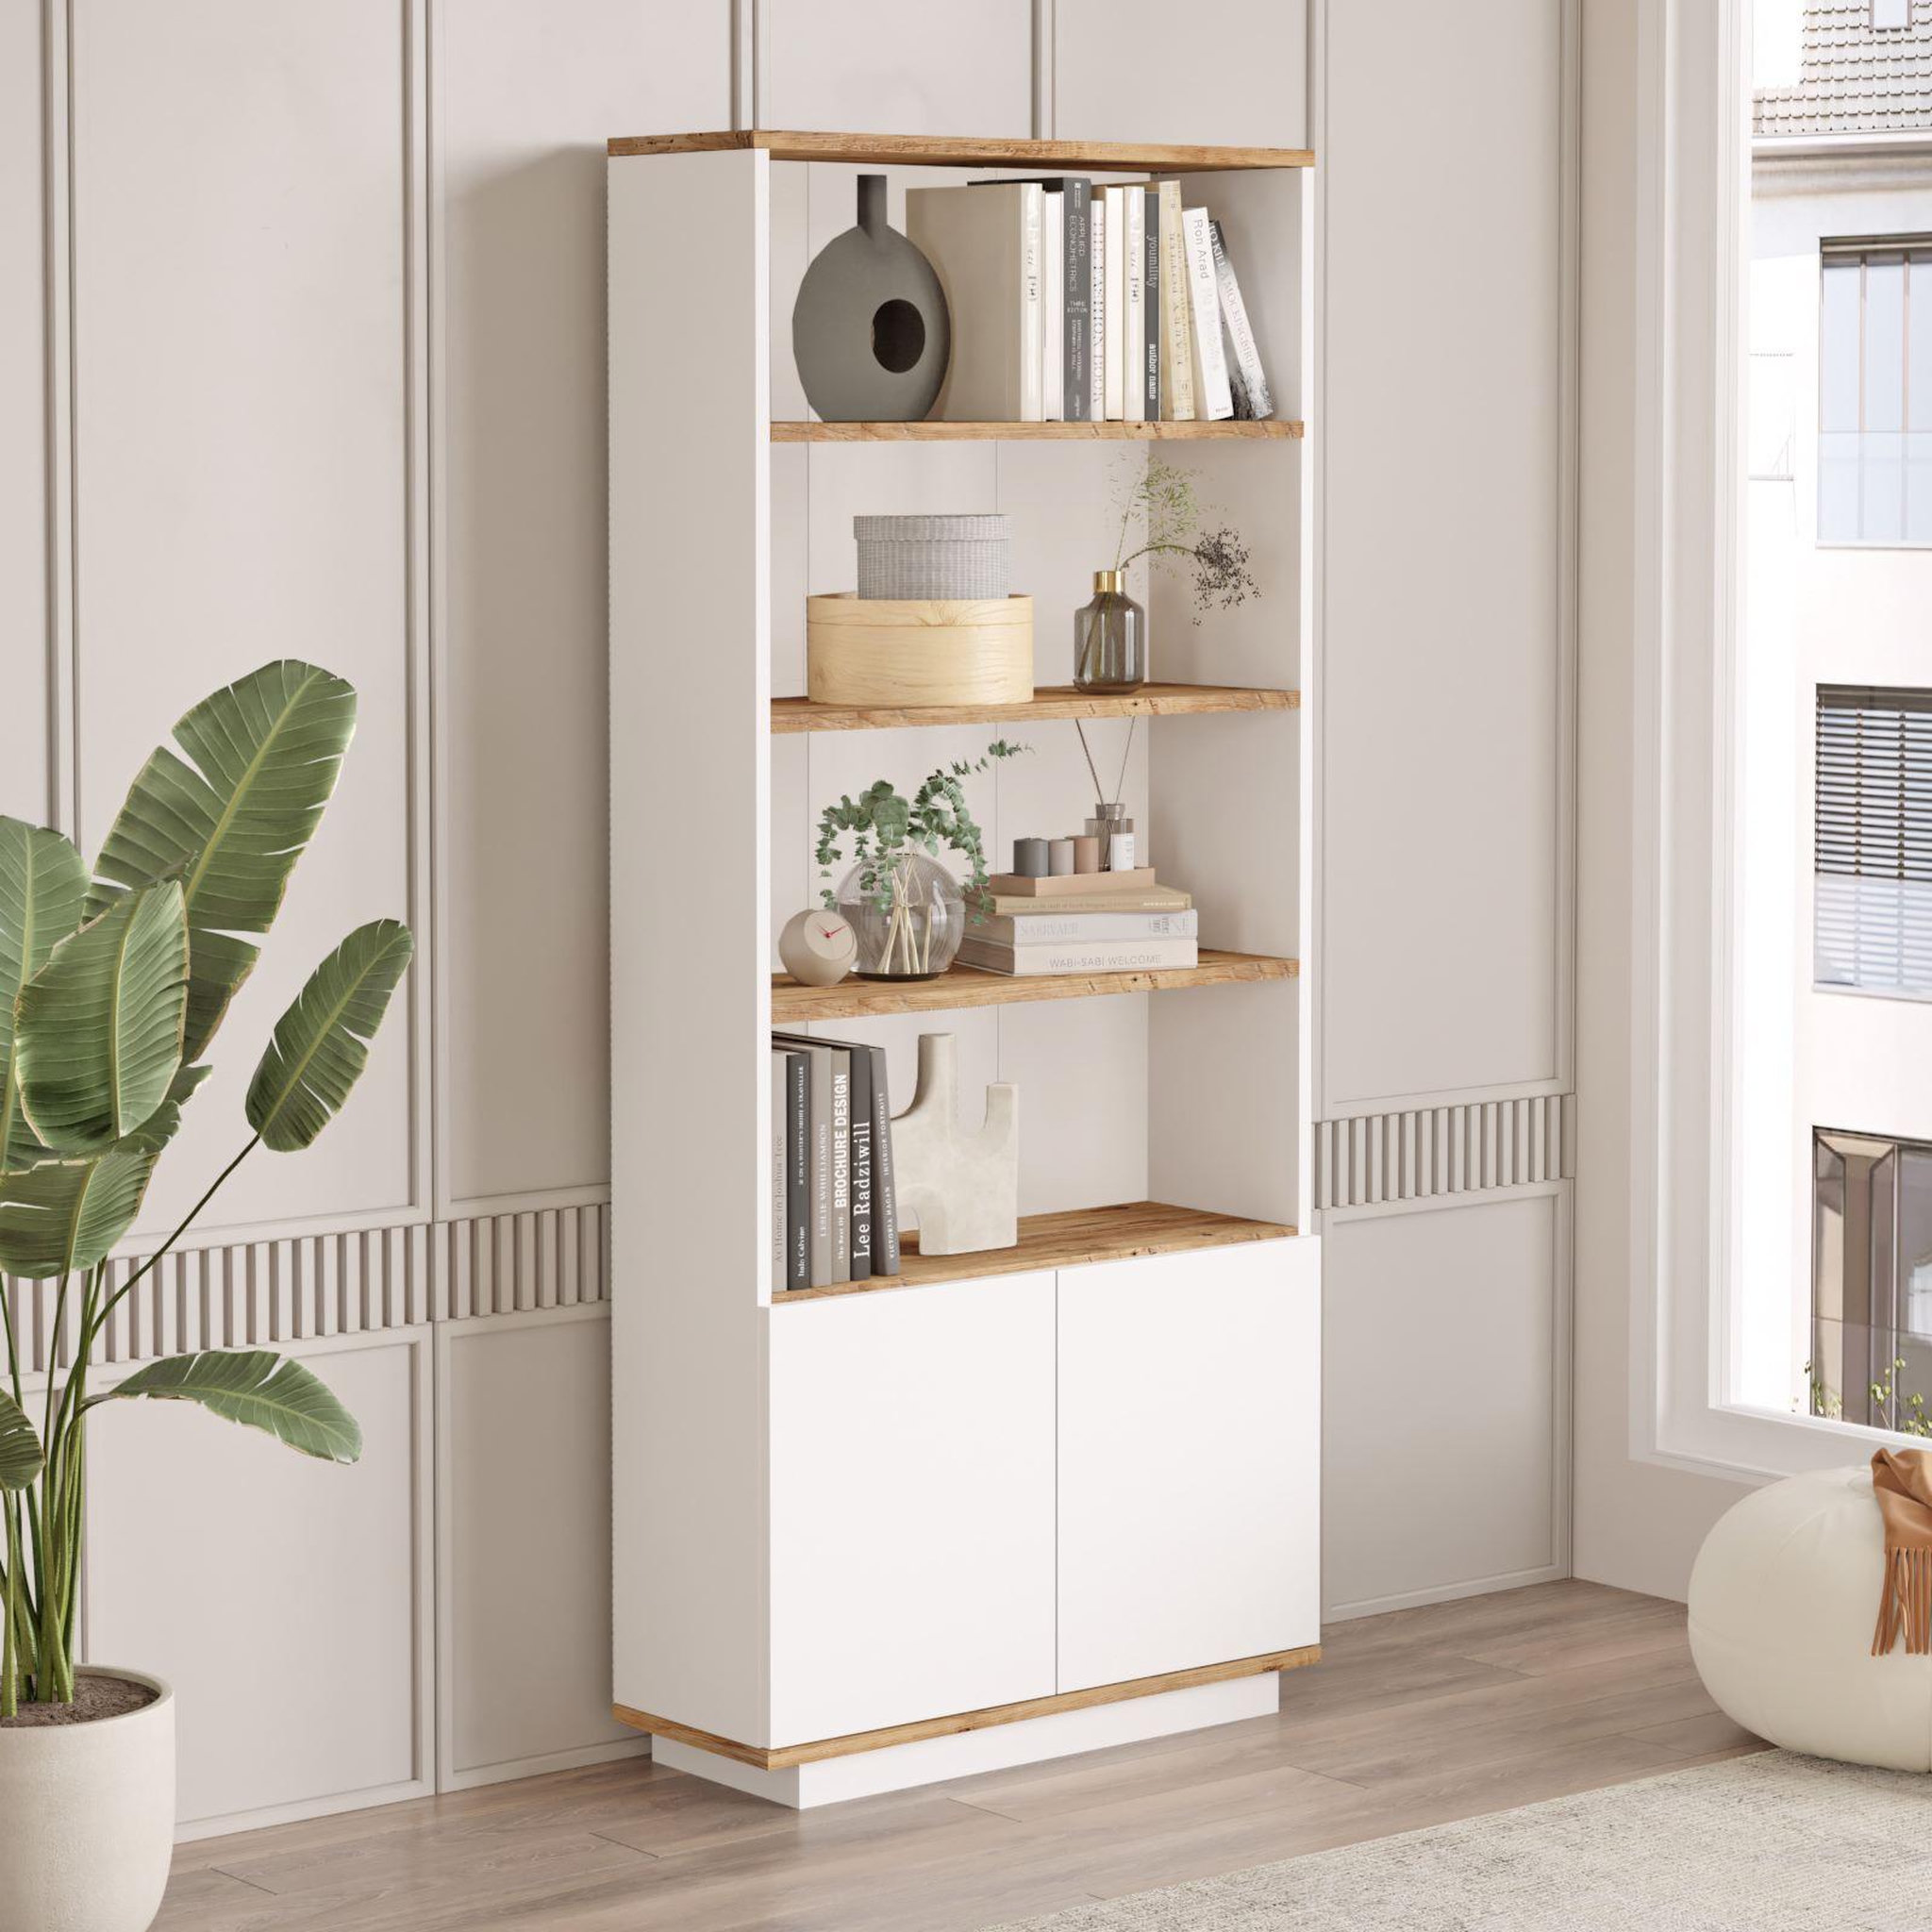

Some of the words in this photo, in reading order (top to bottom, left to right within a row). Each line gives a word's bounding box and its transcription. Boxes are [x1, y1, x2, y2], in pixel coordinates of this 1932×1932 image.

[1193, 218, 1204, 245] Ron
[1146, 234, 1158, 289] youmility
[1197, 249, 1209, 279] Arad
[1149, 343, 1158, 375] author
[1049, 956, 1105, 968] WABI-SABI
[1108, 954, 1162, 966] WELCOME
[834, 1074, 847, 1126] DESIGN
[774, 1162, 785, 1198] Joshua
[834, 1130, 847, 1208] BROCHURE
[853, 1122, 870, 1216] Radziwill
[774, 1217, 783, 1247] Home
[853, 1224, 870, 1258] Lee
